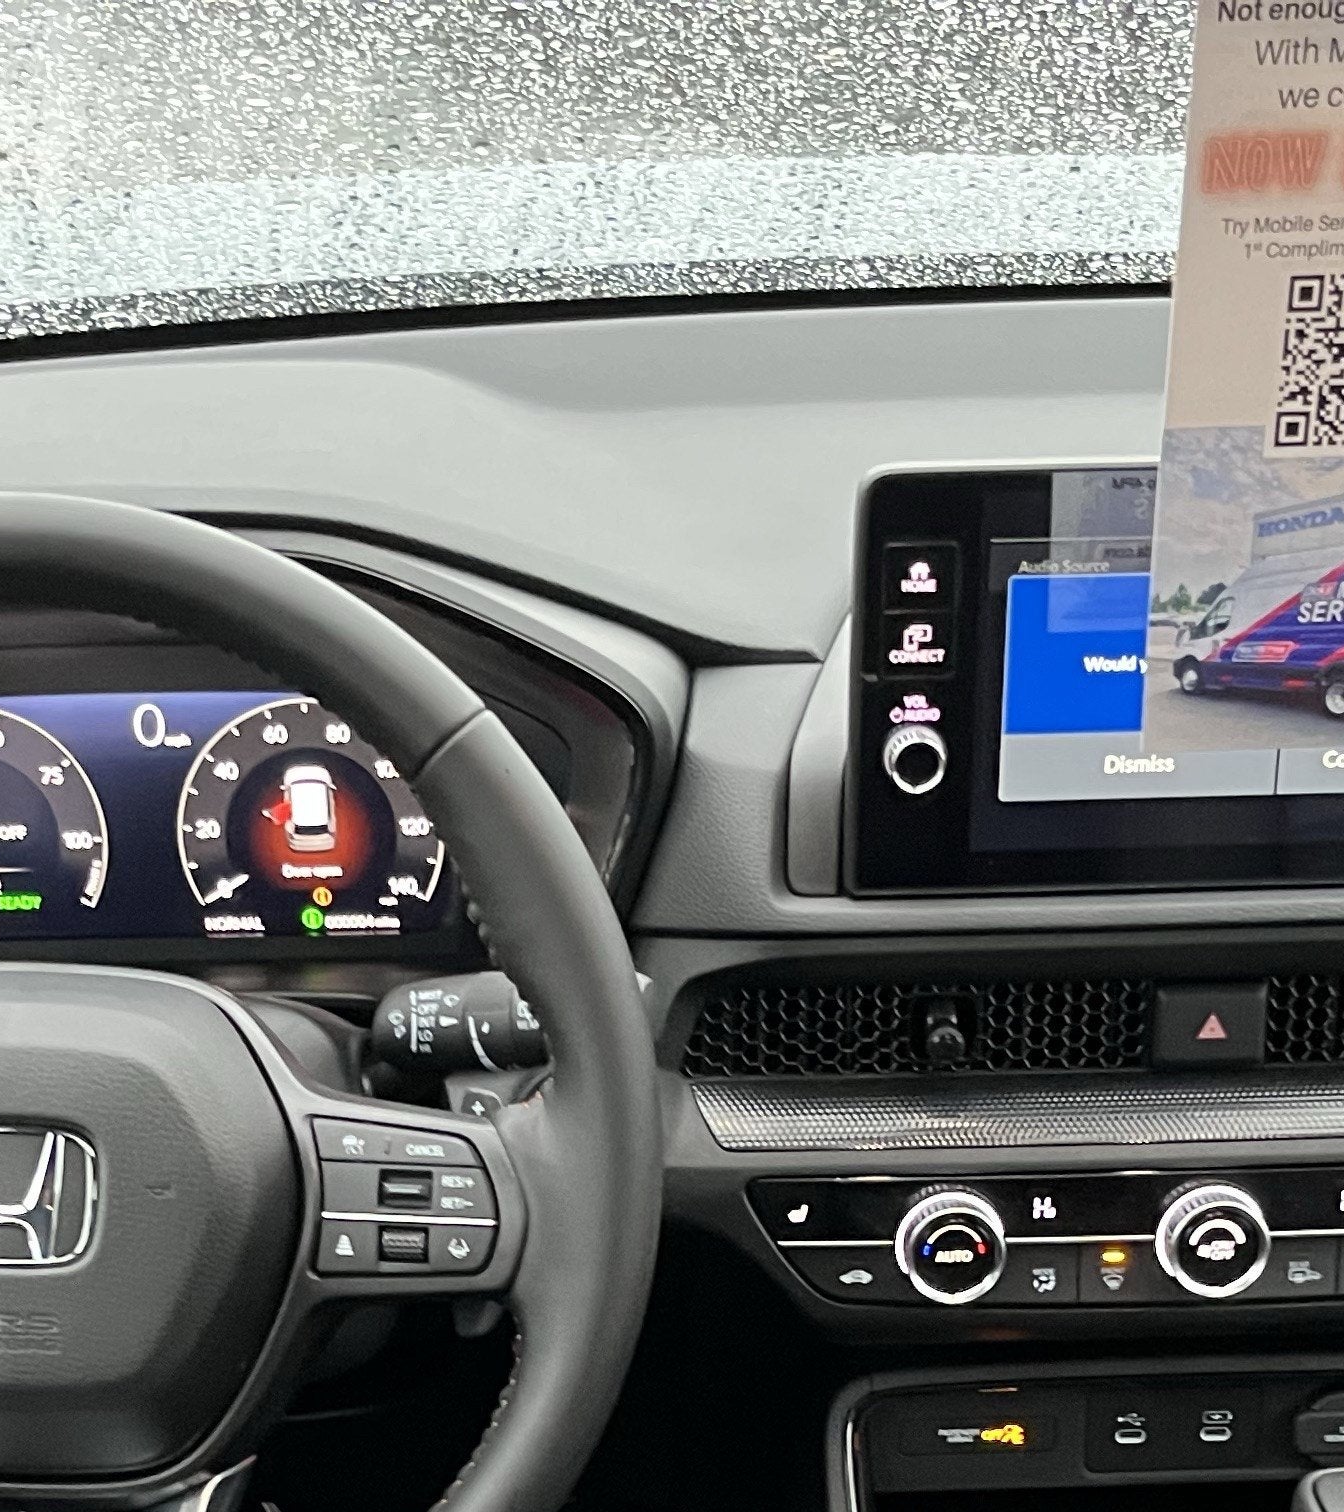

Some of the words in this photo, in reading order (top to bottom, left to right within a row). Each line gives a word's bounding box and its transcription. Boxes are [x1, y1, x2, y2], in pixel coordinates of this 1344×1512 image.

[1217, 0, 1262, 23] Not
[1255, 38, 1319, 66] With
[1278, 86, 1320, 109] we
[1204, 133, 1325, 192] NOW
[1222, 218, 1250, 238] Try
[1254, 214, 1313, 234] Mobile
[1018, 560, 1057, 575] Audio
[1060, 559, 1110, 573] Source
[1083, 654, 1137, 674] Would
[133, 702, 166, 748] 0
[262, 722, 289, 745] 60
[325, 721, 351, 744] 80
[38, 764, 65, 786] 75
[213, 760, 240, 781] 40
[1103, 753, 1175, 776] Dismiss
[194, 818, 221, 840] 20
[398, 815, 432, 837] 120
[62, 829, 93, 850] 100
[934, 1249, 974, 1264] AUTO
